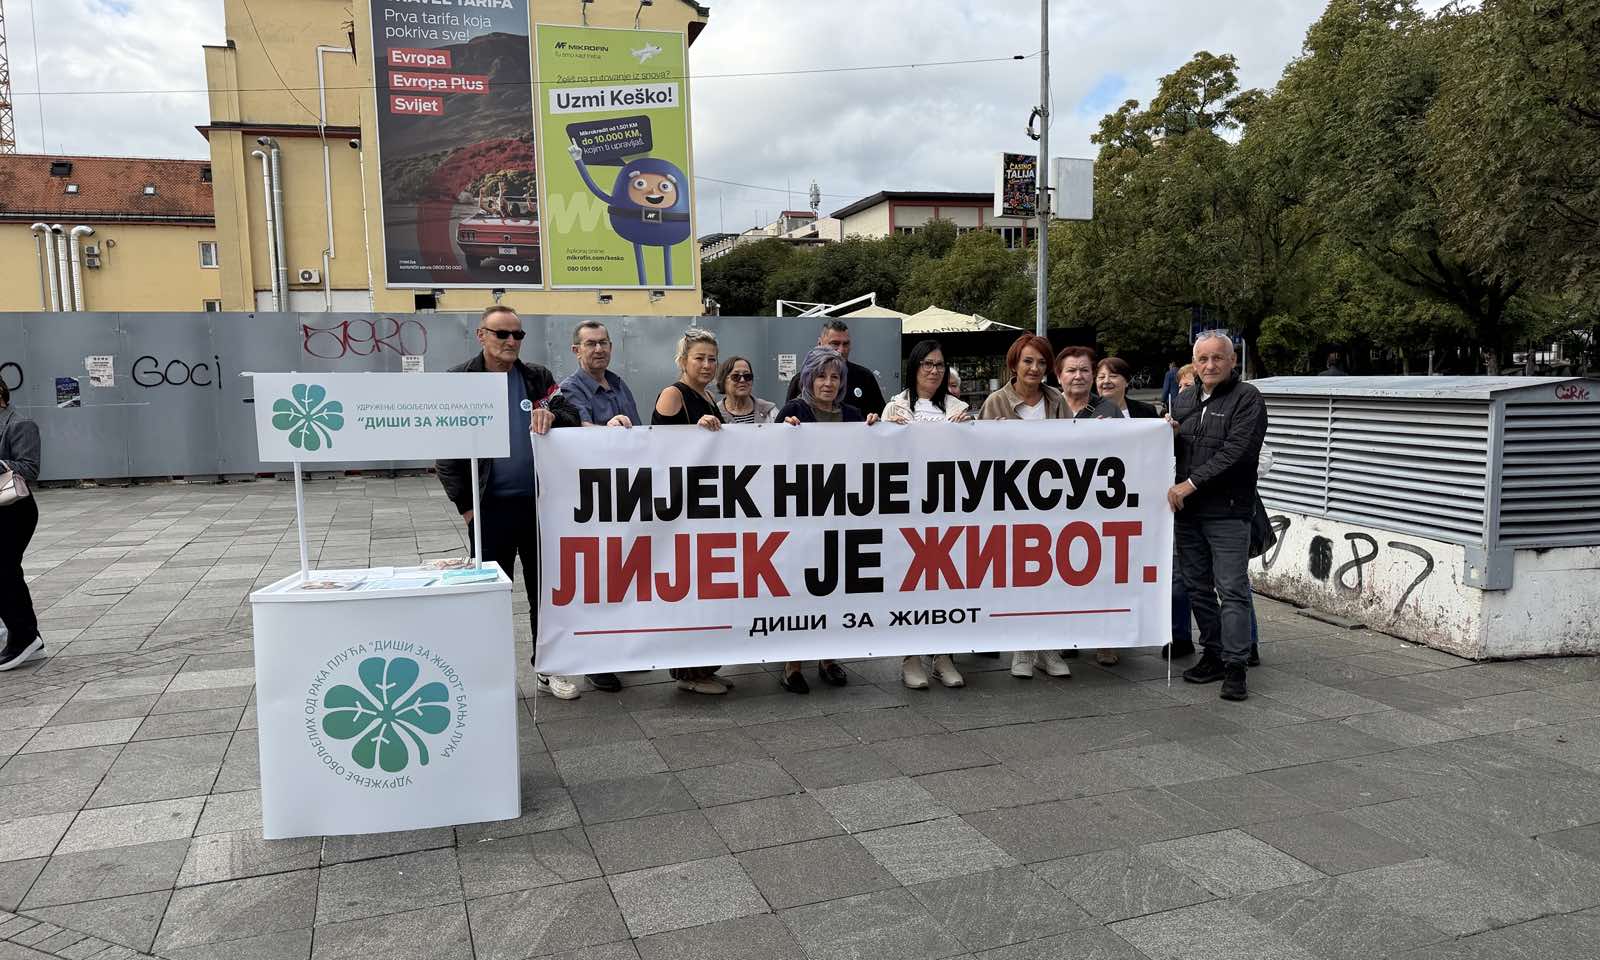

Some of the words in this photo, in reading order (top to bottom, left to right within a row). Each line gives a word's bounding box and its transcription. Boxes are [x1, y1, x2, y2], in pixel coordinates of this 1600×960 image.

[384, 8, 417, 23] Prva
[422, 12, 459, 26] tarifa
[463, 14, 491, 29] koja
[385, 25, 438, 40] pokriva
[442, 30, 470, 41] sve!
[392, 50, 446, 66] Evropa
[393, 74, 447, 90] Evropa
[451, 77, 484, 91] Plus
[395, 98, 439, 112] Svijet
[556, 90, 605, 109] Uzmi
[610, 86, 672, 107] Keško!
[582, 137, 593, 145] do
[594, 132, 623, 144] 10.000
[1006, 169, 1035, 179] TALIJA
[439, 403, 450, 411] ОД
[414, 416, 432, 428] ЗА
[573, 464, 762, 523] ЛИЈЕК
[773, 462, 910, 518] НИЈЕ
[921, 456, 1139, 514] ЛУКСУЗ.
[551, 531, 792, 606] ЛИЈЕК
[804, 528, 884, 597] ЈЕ
[898, 520, 1157, 592] ЖИВОТ.
[749, 614, 827, 637] ДИШИ
[842, 612, 874, 629] ЗА
[888, 607, 982, 627] ЖИВОТ
[415, 645, 430, 660] ЗА
[310, 669, 329, 696] РАКА
[304, 697, 319, 714] ОД
[455, 694, 467, 729] БАЊА
[304, 717, 345, 776] ОБОЉЕЛИХ
[440, 729, 464, 758] ЛУКА
[345, 771, 414, 789] УДРУЖЕЊЕ
